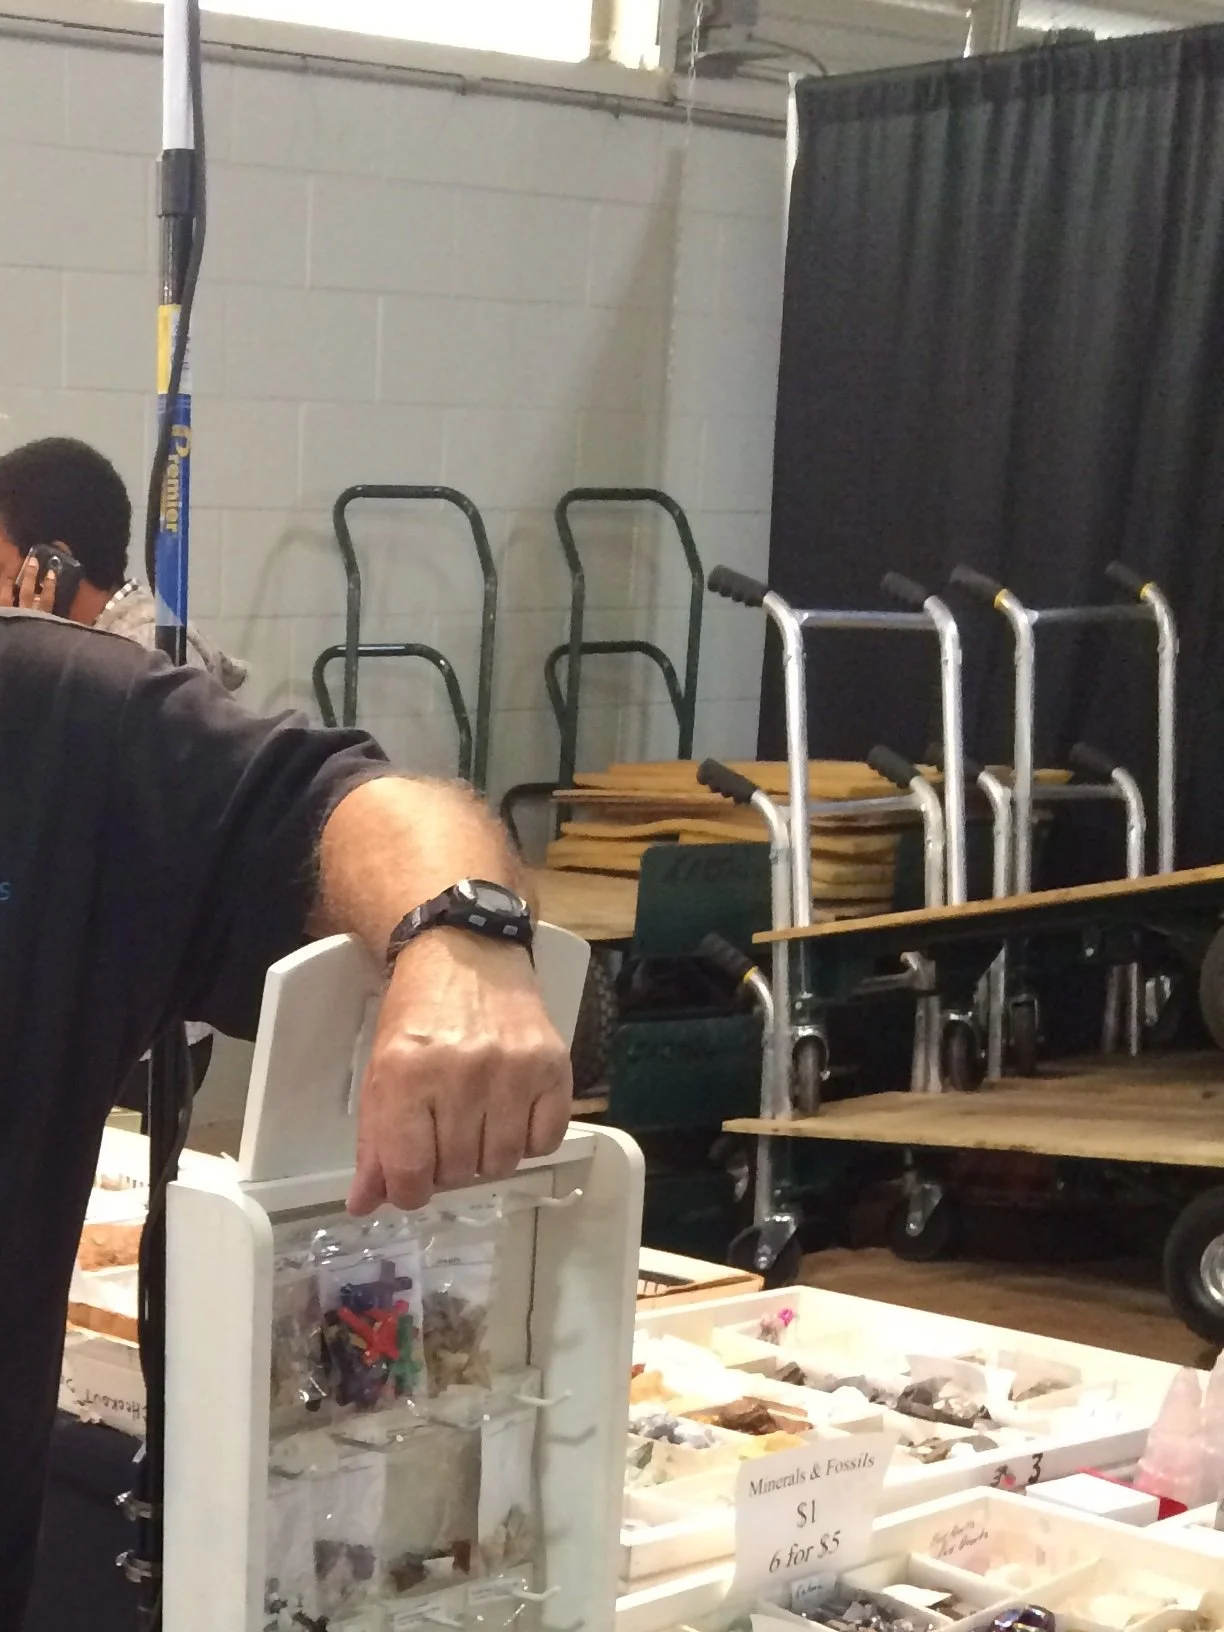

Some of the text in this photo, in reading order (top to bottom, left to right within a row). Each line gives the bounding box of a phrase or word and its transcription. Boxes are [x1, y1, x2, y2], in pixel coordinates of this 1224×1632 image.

[165, 424, 193, 533] Premier
[749, 1453, 875, 1497] Minerals & Fossils
[1028, 1452, 1044, 1485] 3
[796, 1499, 816, 1528] $1
[769, 1530, 841, 1573] 6 for $5
